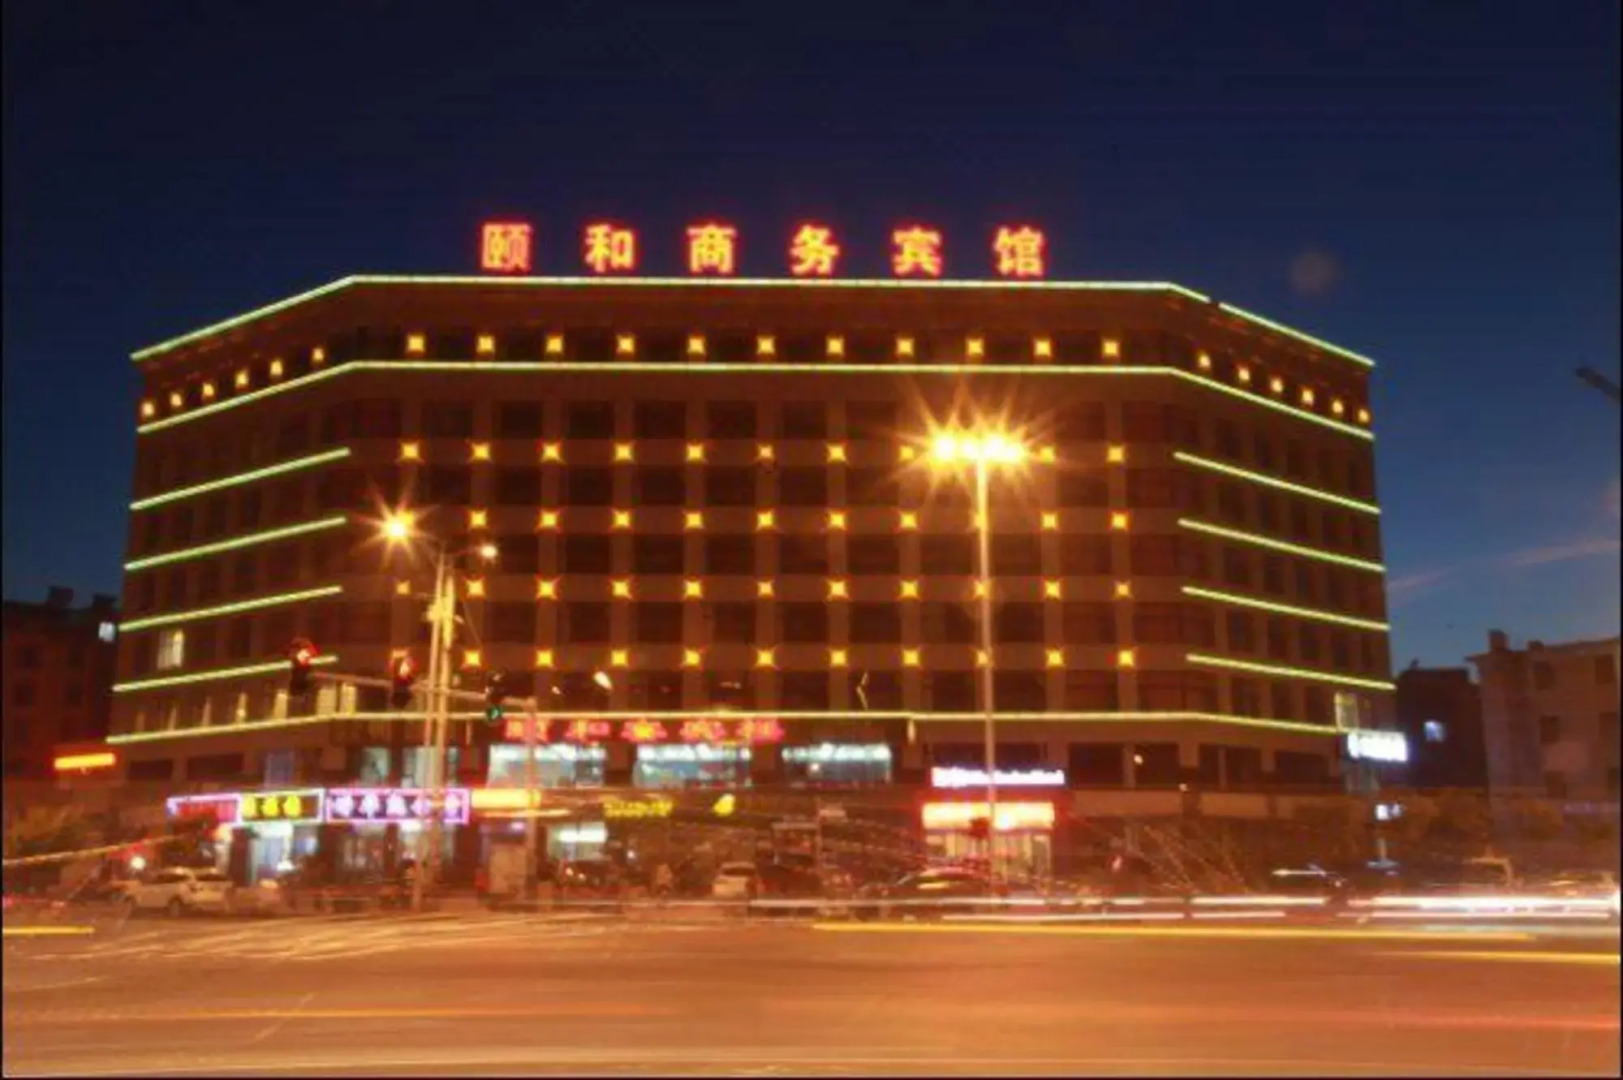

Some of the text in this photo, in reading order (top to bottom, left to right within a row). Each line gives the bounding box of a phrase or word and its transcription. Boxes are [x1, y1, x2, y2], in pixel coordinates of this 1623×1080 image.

[481, 222, 1045, 275] 颐和商务宾馆
